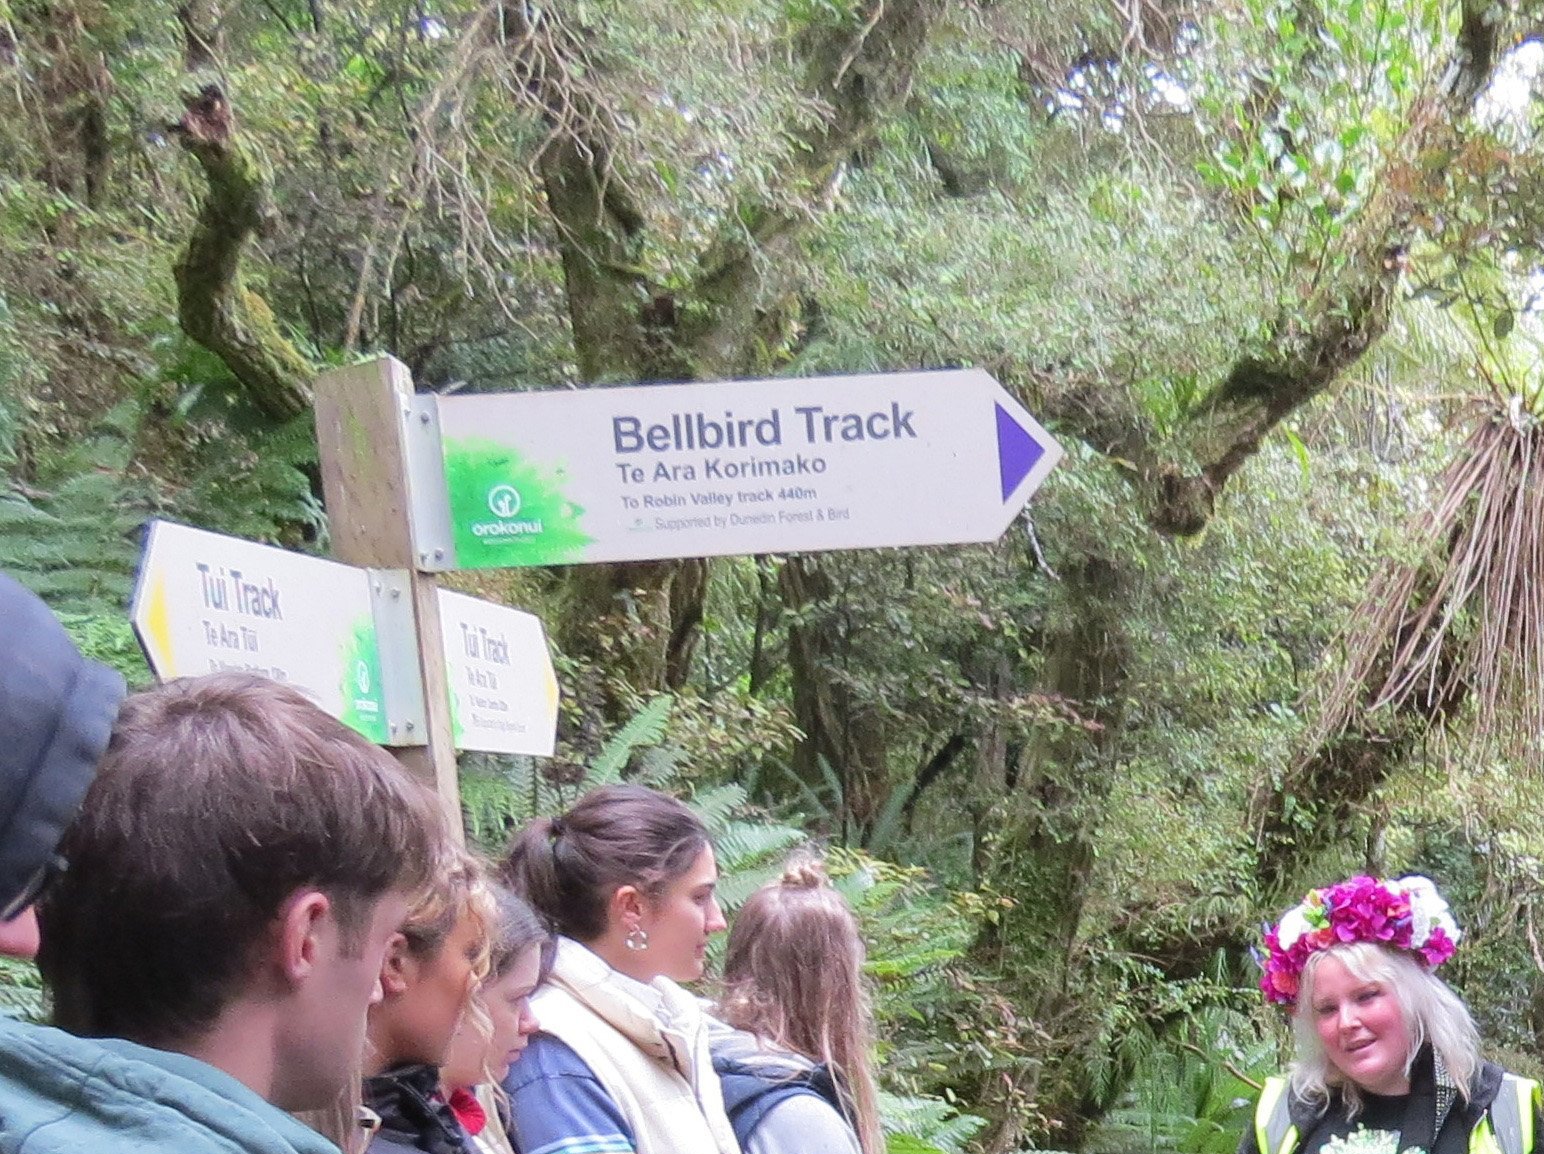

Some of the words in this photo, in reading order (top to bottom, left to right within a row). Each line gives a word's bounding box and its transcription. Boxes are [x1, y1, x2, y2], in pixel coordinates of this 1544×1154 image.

[612, 408, 782, 454] Bellbird
[795, 401, 917, 444] Track
[616, 463, 645, 484] Te
[653, 461, 696, 482] Ara
[705, 454, 827, 479] Korimako
[621, 496, 640, 510] To
[643, 494, 687, 509] Robin
[690, 492, 733, 507] Valley
[738, 489, 774, 502] track
[778, 487, 817, 500] 440m
[472, 519, 544, 536] orokonui
[655, 515, 712, 532] Supported
[714, 515, 728, 529] by
[729, 512, 776, 526] Dunedin
[779, 510, 814, 522] Forest
[827, 508, 850, 520] Bird
[196, 562, 229, 611] Tui
[230, 569, 283, 620] Track
[202, 620, 218, 647] Te
[221, 623, 239, 650] Ara
[460, 622, 479, 659] Tui
[479, 627, 510, 666] Track
